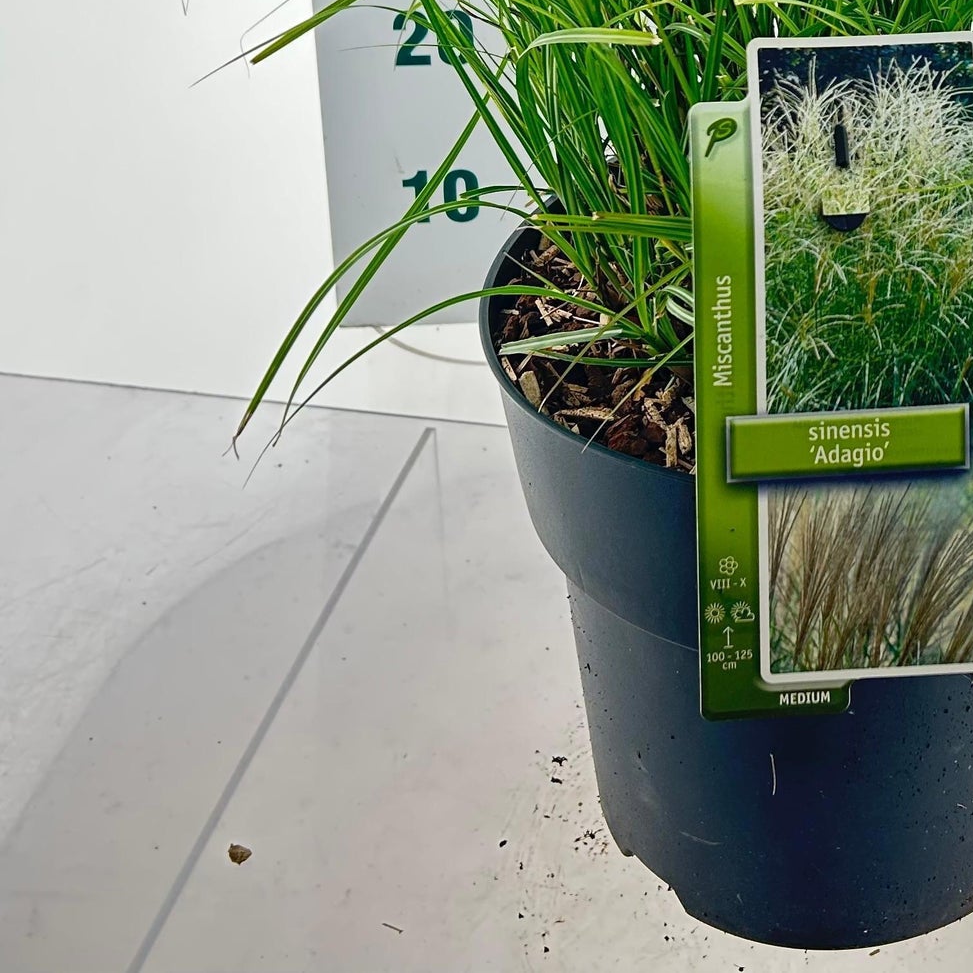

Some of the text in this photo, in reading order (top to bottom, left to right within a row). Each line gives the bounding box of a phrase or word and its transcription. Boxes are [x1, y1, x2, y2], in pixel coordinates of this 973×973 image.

[402, 169, 480, 224] 10
[711, 275, 733, 388] Miscanthus
[808, 418, 890, 441] sinensis
[710, 578, 731, 590] VIII
[740, 578, 747, 587] X
[706, 651, 725, 662] 100
[735, 649, 753, 660] 125
[722, 660, 737, 670] cm
[779, 691, 831, 706] MEDIUM
